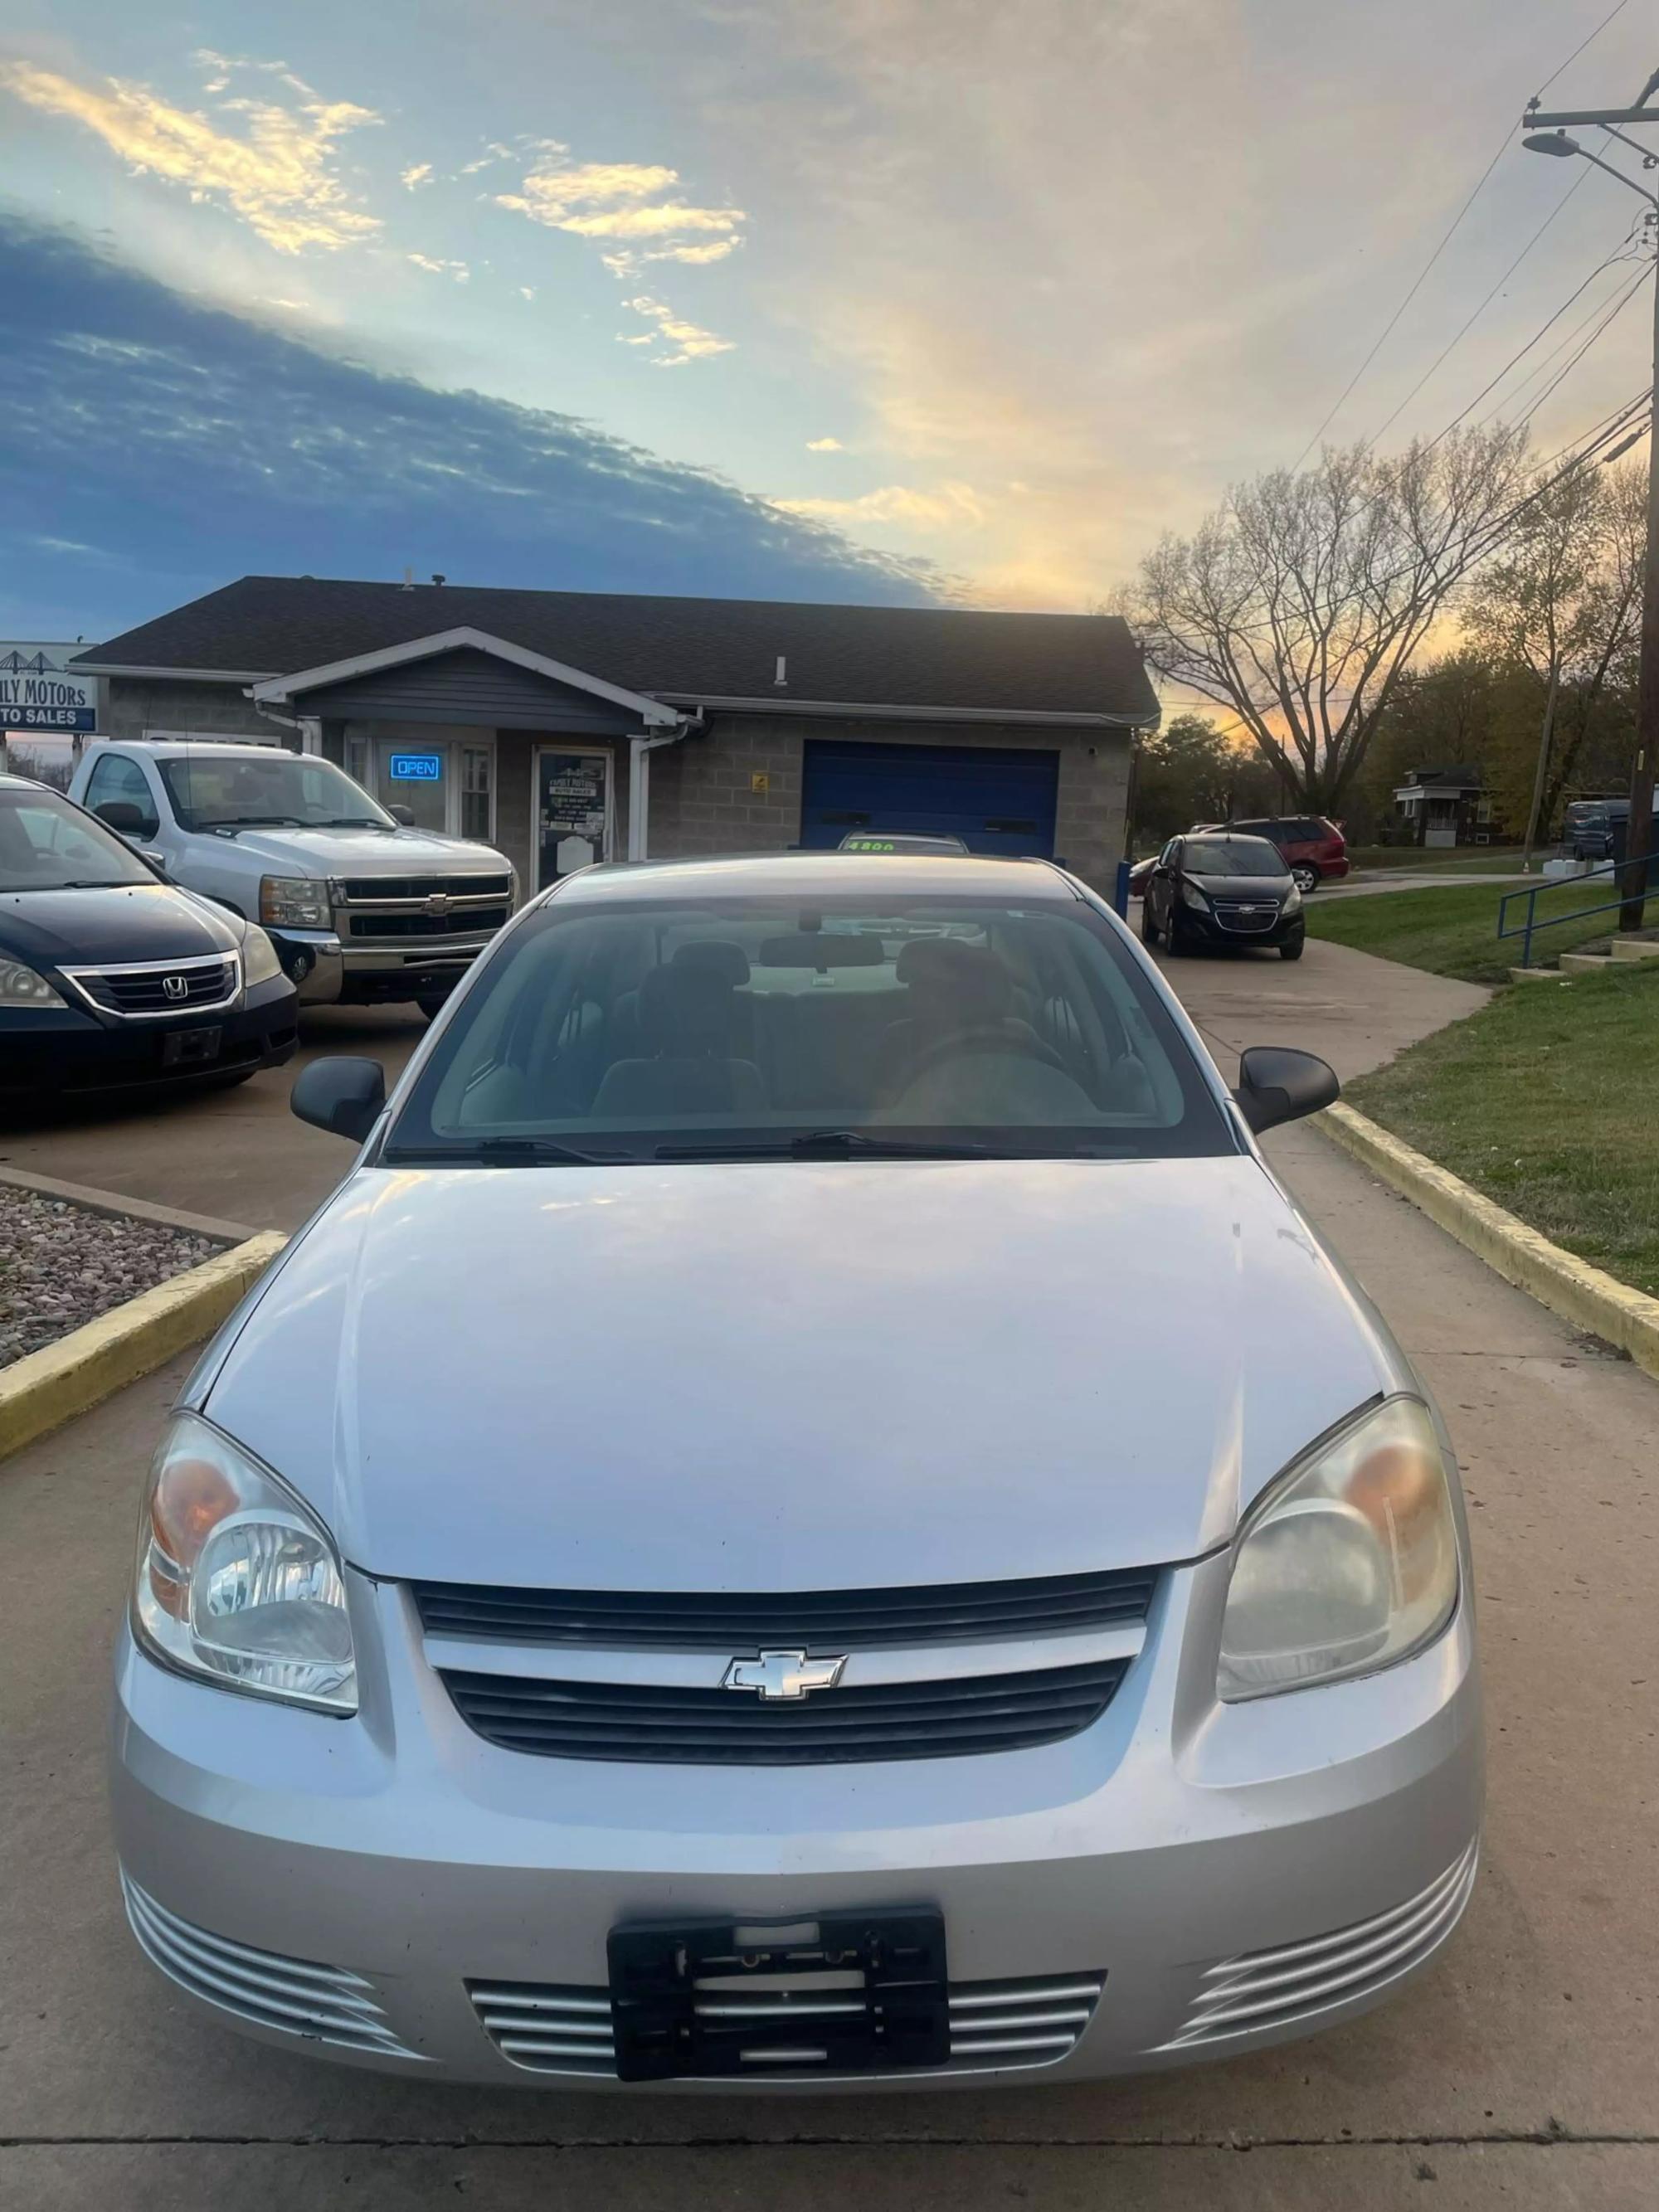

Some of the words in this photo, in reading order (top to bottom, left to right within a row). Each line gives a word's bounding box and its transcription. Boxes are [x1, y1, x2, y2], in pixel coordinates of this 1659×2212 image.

[25, 679, 85, 706] MOTORS
[26, 709, 76, 725] SALES
[398, 761, 435, 775] OPEN
